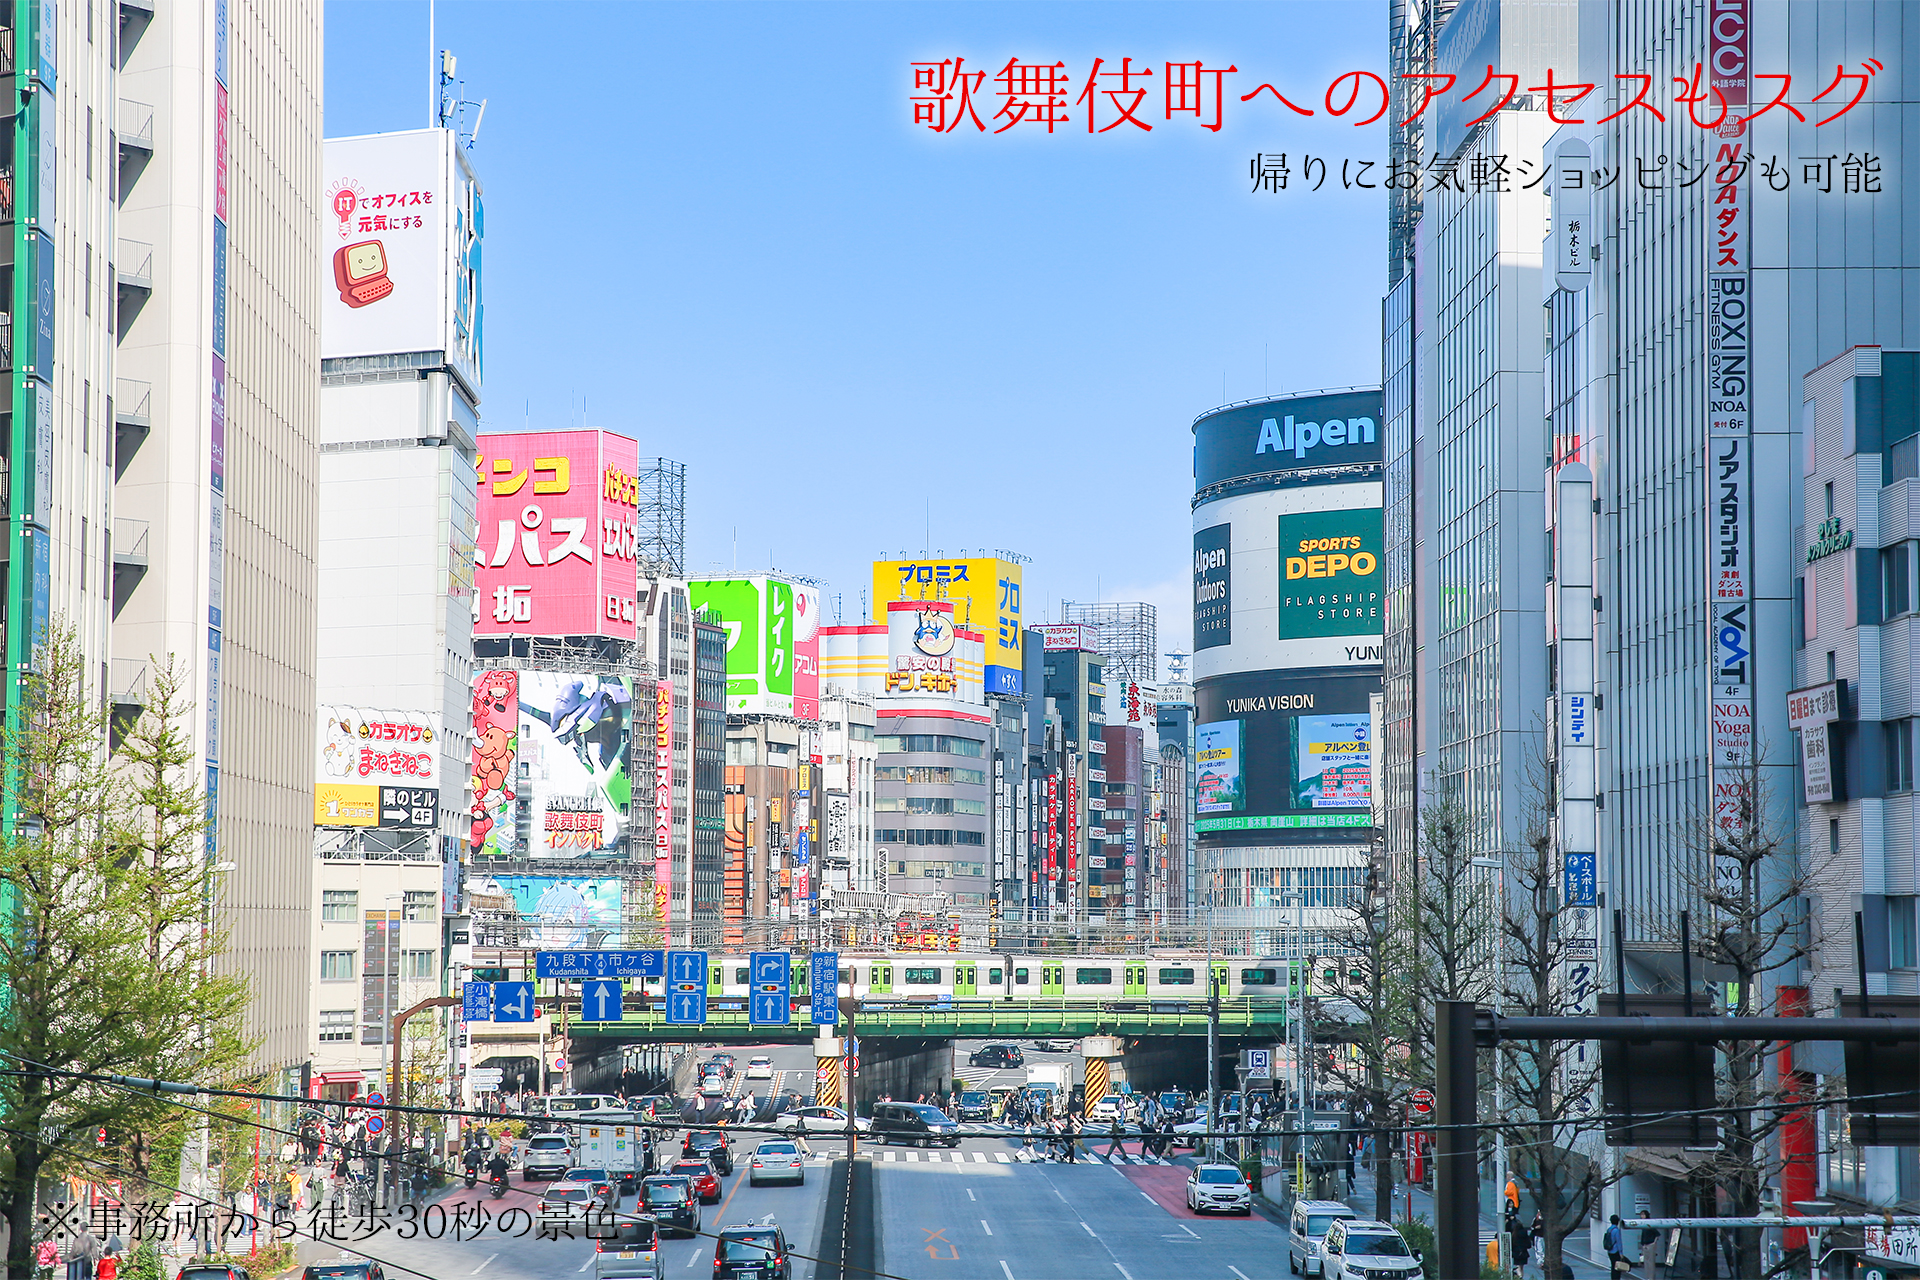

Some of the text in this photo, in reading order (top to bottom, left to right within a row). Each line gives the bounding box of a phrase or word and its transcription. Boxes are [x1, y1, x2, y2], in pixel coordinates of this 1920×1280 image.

[1711, 79, 1746, 88] 外語学院
[337, 190, 433, 212] IT でオフィスを
[358, 214, 423, 233] 元気にする
[1568, 220, 1580, 267] 栃木ビル
[39, 317, 52, 341] Zina
[1711, 278, 1721, 389] FITNESS GYM
[1721, 278, 1746, 397] BOXING
[1711, 400, 1747, 413] NOA
[1729, 418, 1744, 430] 6F
[1255, 414, 1375, 459] Alpen
[604, 461, 639, 506] パチンコ
[1719, 440, 1740, 568] ノアスタジオ
[603, 511, 638, 560] エスパス
[1299, 536, 1362, 553] SPORTS
[1195, 547, 1226, 578] Alpen
[1286, 551, 1377, 581] DEPO
[898, 564, 970, 582] プロミス
[1196, 579, 1226, 604] Outdoors
[1718, 579, 1743, 589] ダンス
[606, 593, 634, 623] 日拓
[1285, 592, 1377, 607] FLAGSHIP
[1195, 604, 1227, 621] FLAGSHIP
[1318, 608, 1377, 620] STORE
[771, 585, 785, 678] レイク
[1050, 627, 1073, 635] カラオケ
[1202, 619, 1227, 632] STORE
[1045, 636, 1078, 647] まねきねこ
[794, 653, 818, 677] アコム
[896, 654, 956, 672] 驚安の殿
[1725, 686, 1740, 696] 4F
[801, 703, 810, 716] 3F
[1227, 694, 1314, 713] YUNIKA VISION
[1714, 704, 1750, 718] NOA
[1790, 688, 1837, 721] 日曜日まで診療
[1088, 711, 1107, 725] DARTS
[369, 721, 423, 743] カラオケ
[1714, 719, 1751, 737] Yoga
[1804, 725, 1825, 740] カラサワ
[1717, 738, 1749, 747] Studio
[1806, 738, 1826, 760] 歯科
[358, 745, 432, 777] まねきねこ
[1726, 751, 1741, 762] 9F
[383, 788, 436, 808] 隣のビル
[342, 806, 375, 819] ワンカラ
[413, 811, 431, 822] 4F
[544, 812, 604, 831] 歌舞伎町
[1200, 816, 1244, 830] 2025年5月31日(土)
[1247, 816, 1268, 828] 栃木県
[544, 830, 605, 850] インパクト
[1580, 855, 1593, 901] ベースボール
[546, 953, 593, 967] 九段下
[549, 967, 647, 976] Kudanshita Ichigaya
[814, 957, 823, 991] Shinjuku
[823, 955, 835, 1021] 新宿駅東口
[475, 984, 489, 1019] 小滝橋
